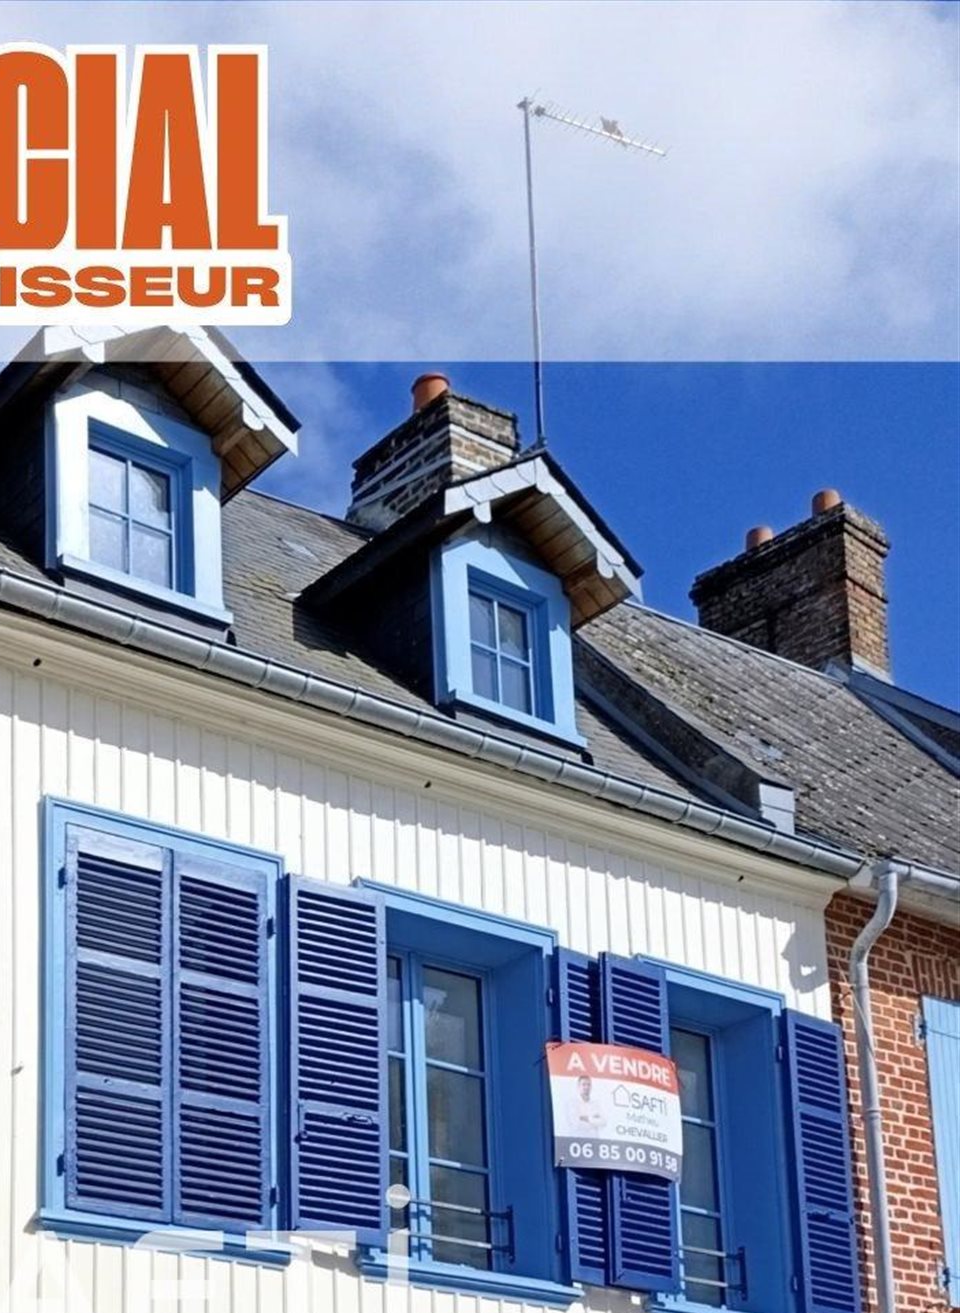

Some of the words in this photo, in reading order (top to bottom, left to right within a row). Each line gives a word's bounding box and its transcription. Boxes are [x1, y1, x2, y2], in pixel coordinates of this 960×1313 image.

[567, 1052, 585, 1072] A
[591, 1054, 671, 1087] VENDRE
[569, 1142, 594, 1158] 06
[599, 1144, 621, 1160] 85
[625, 1146, 646, 1163] 00
[649, 1151, 663, 1168] 91
